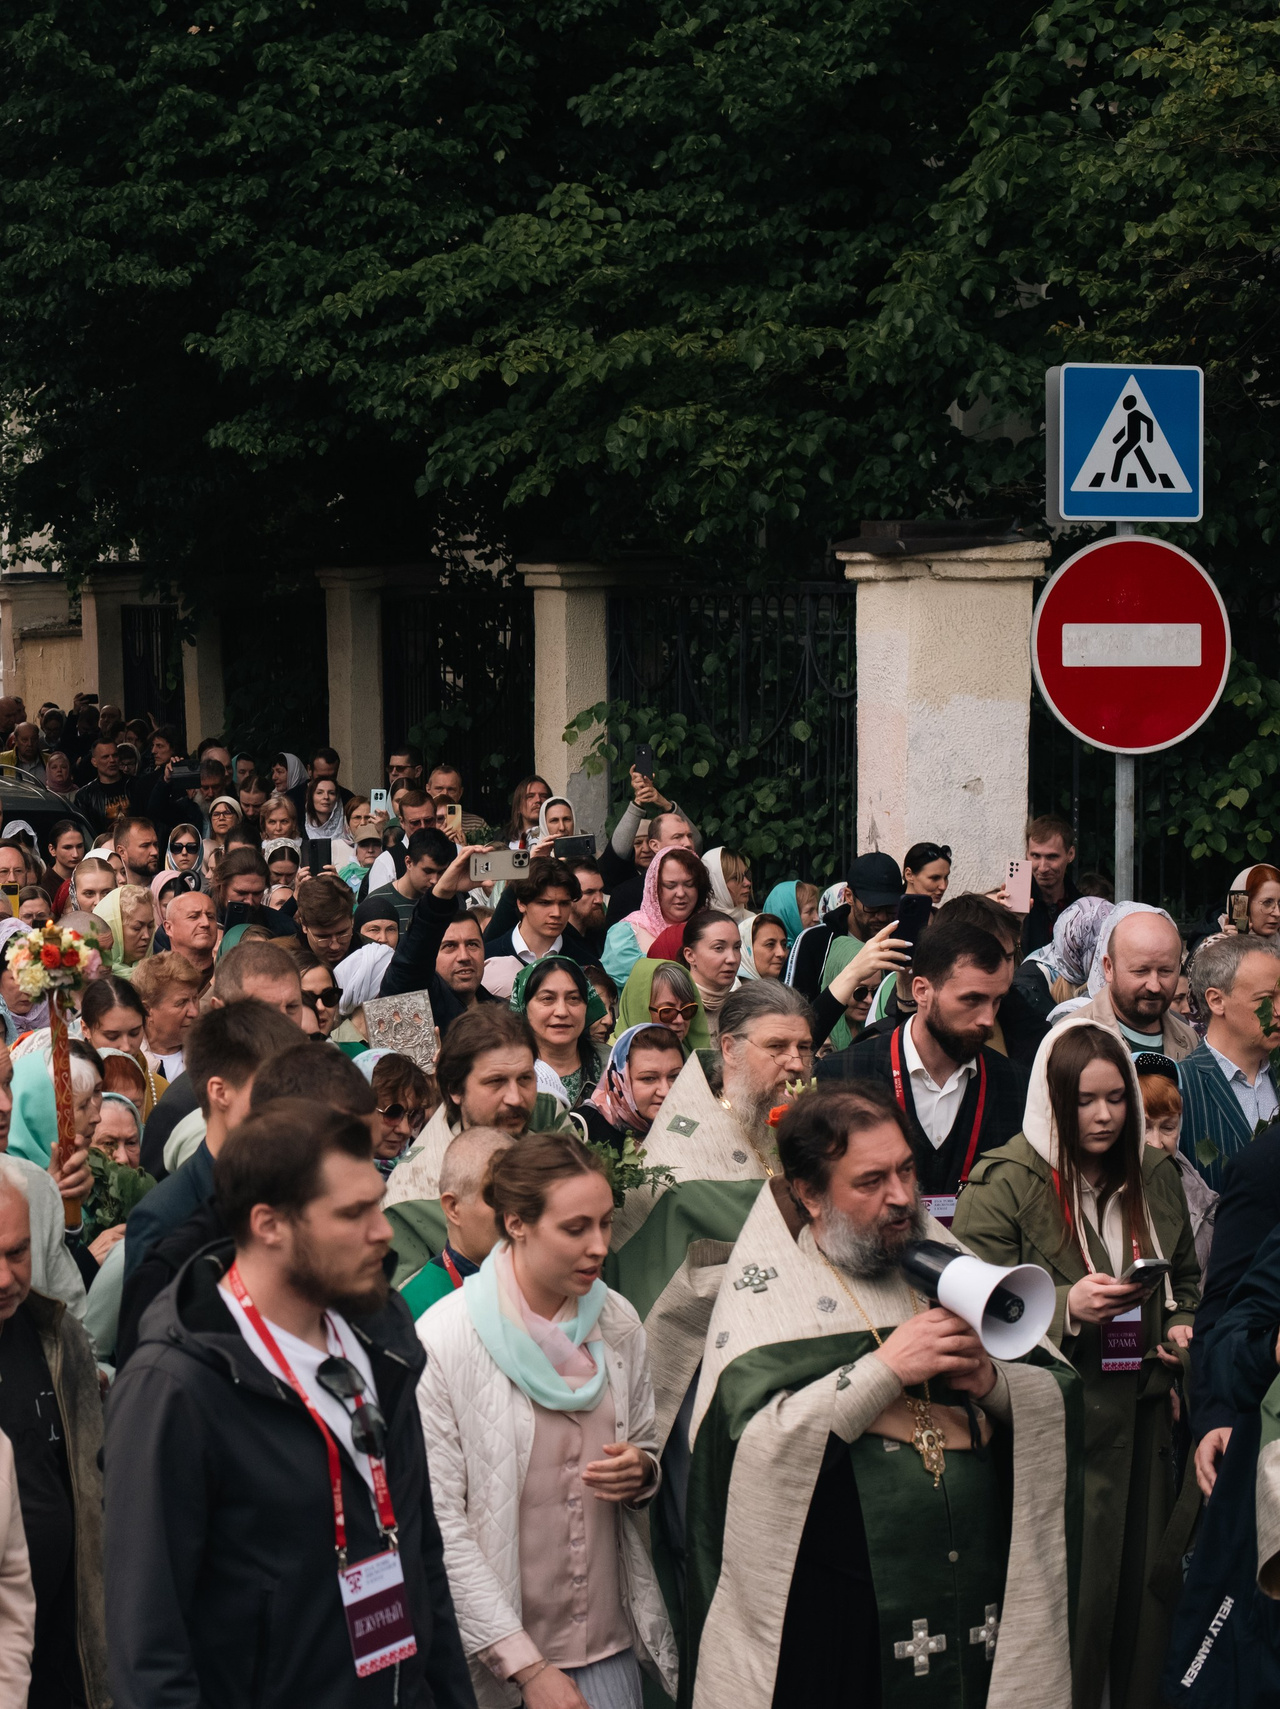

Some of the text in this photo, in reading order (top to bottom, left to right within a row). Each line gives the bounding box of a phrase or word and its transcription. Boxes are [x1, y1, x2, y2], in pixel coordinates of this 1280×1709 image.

[1108, 1338, 1137, 1348] ХРАМА
[354, 1602, 404, 1638] ДЕЖУРНЫЙ
[1180, 1595, 1235, 1688] HELLY HANSEN
